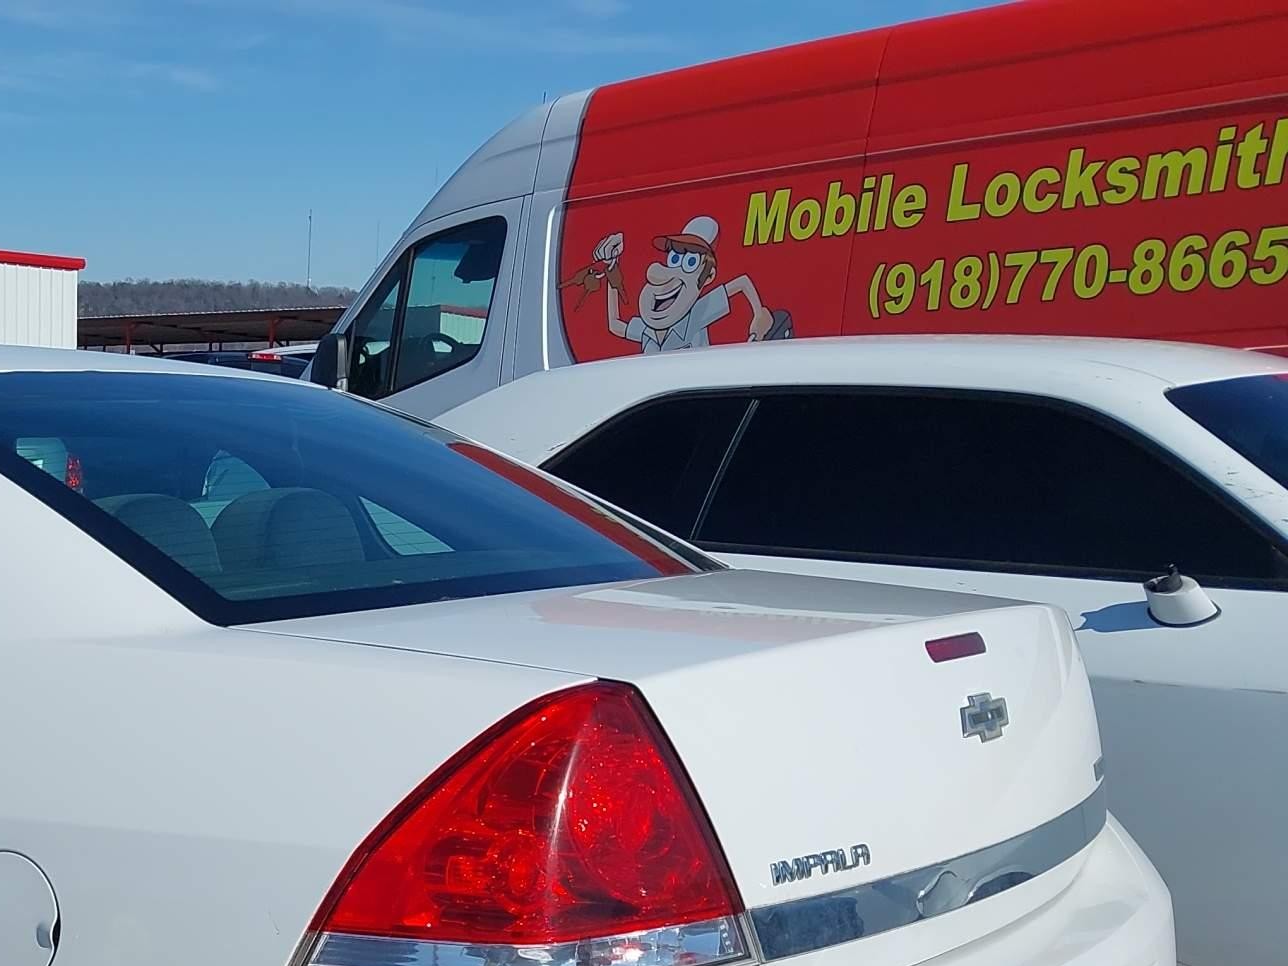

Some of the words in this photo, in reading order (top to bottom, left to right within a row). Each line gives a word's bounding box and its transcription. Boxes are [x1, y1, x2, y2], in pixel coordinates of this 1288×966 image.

[742, 173, 927, 246] Mobile
[868, 225, 1288, 319] (918)770-8665
[770, 843, 871, 886] IMPALA
